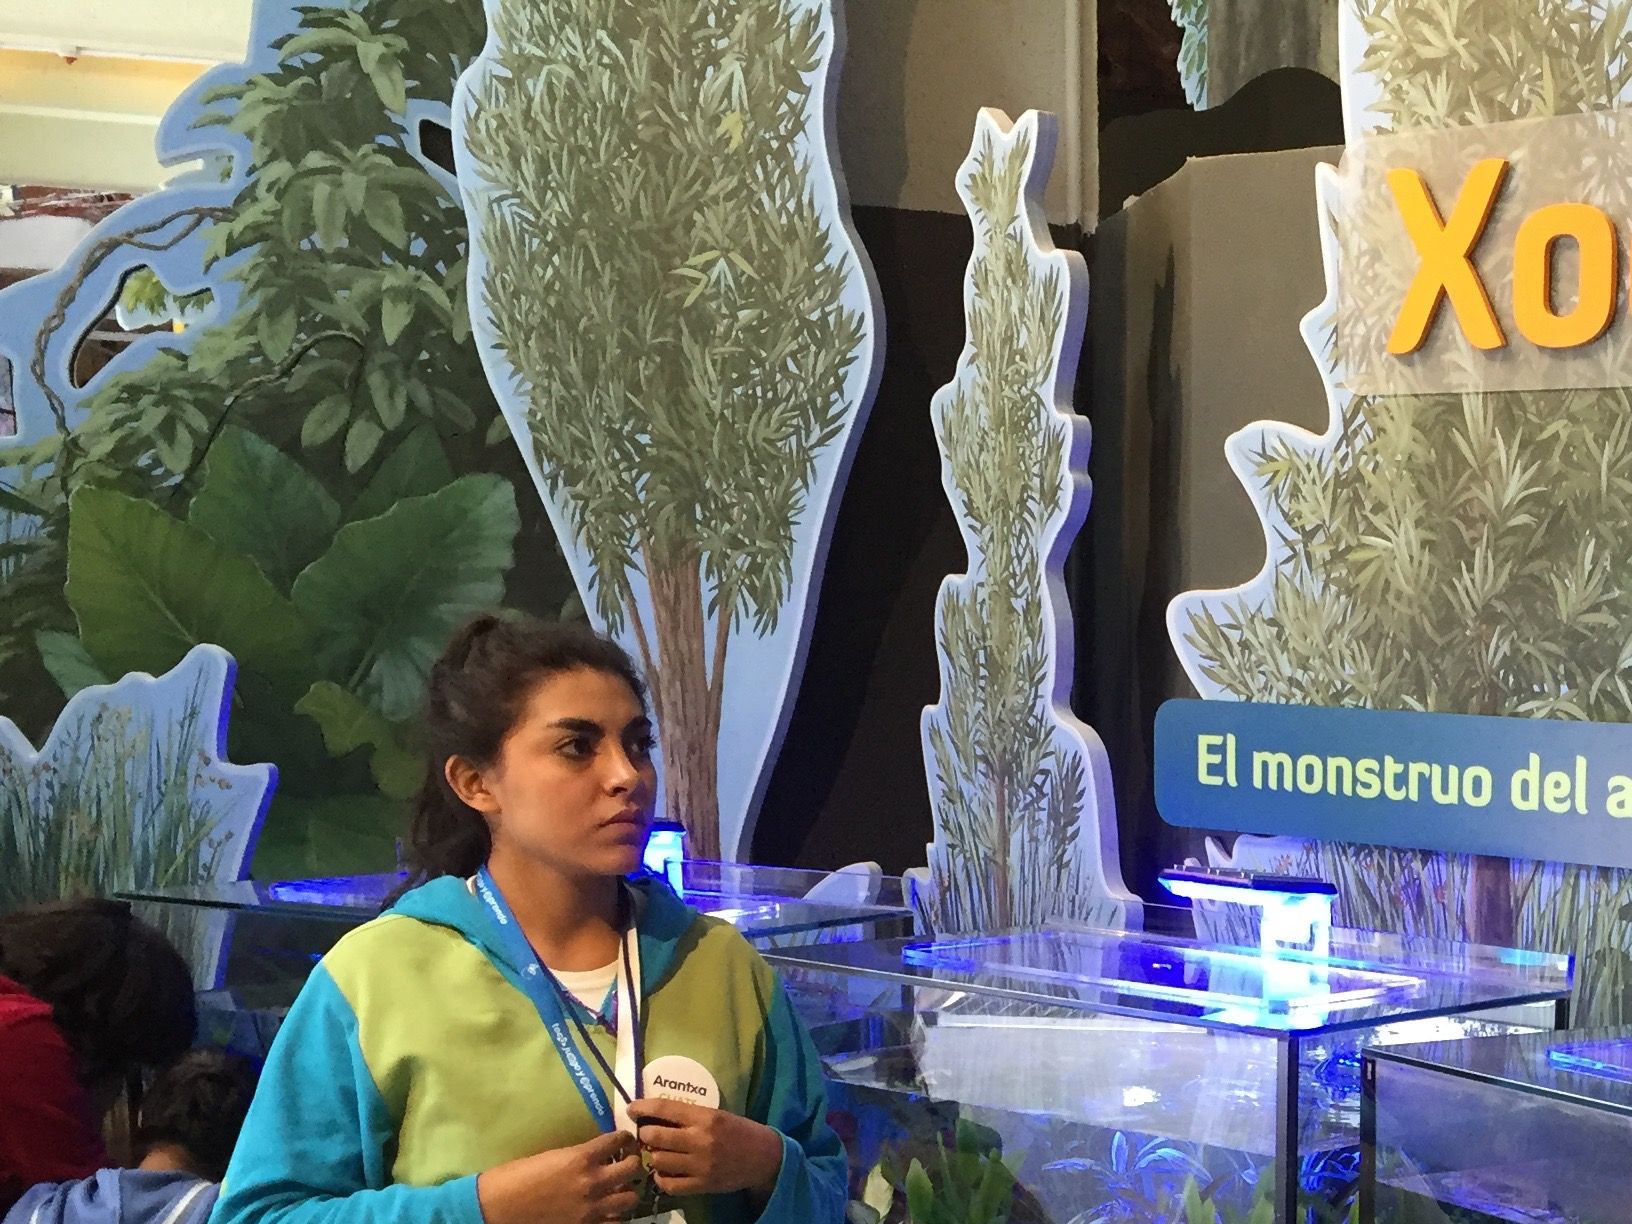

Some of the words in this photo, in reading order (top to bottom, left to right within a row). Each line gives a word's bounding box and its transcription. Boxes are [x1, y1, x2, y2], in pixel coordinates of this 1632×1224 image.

[1198, 734, 1237, 787] El
[1252, 750, 1493, 808] monstruo
[1510, 753, 1589, 815] del
[652, 1074, 707, 1097] Arantxa
